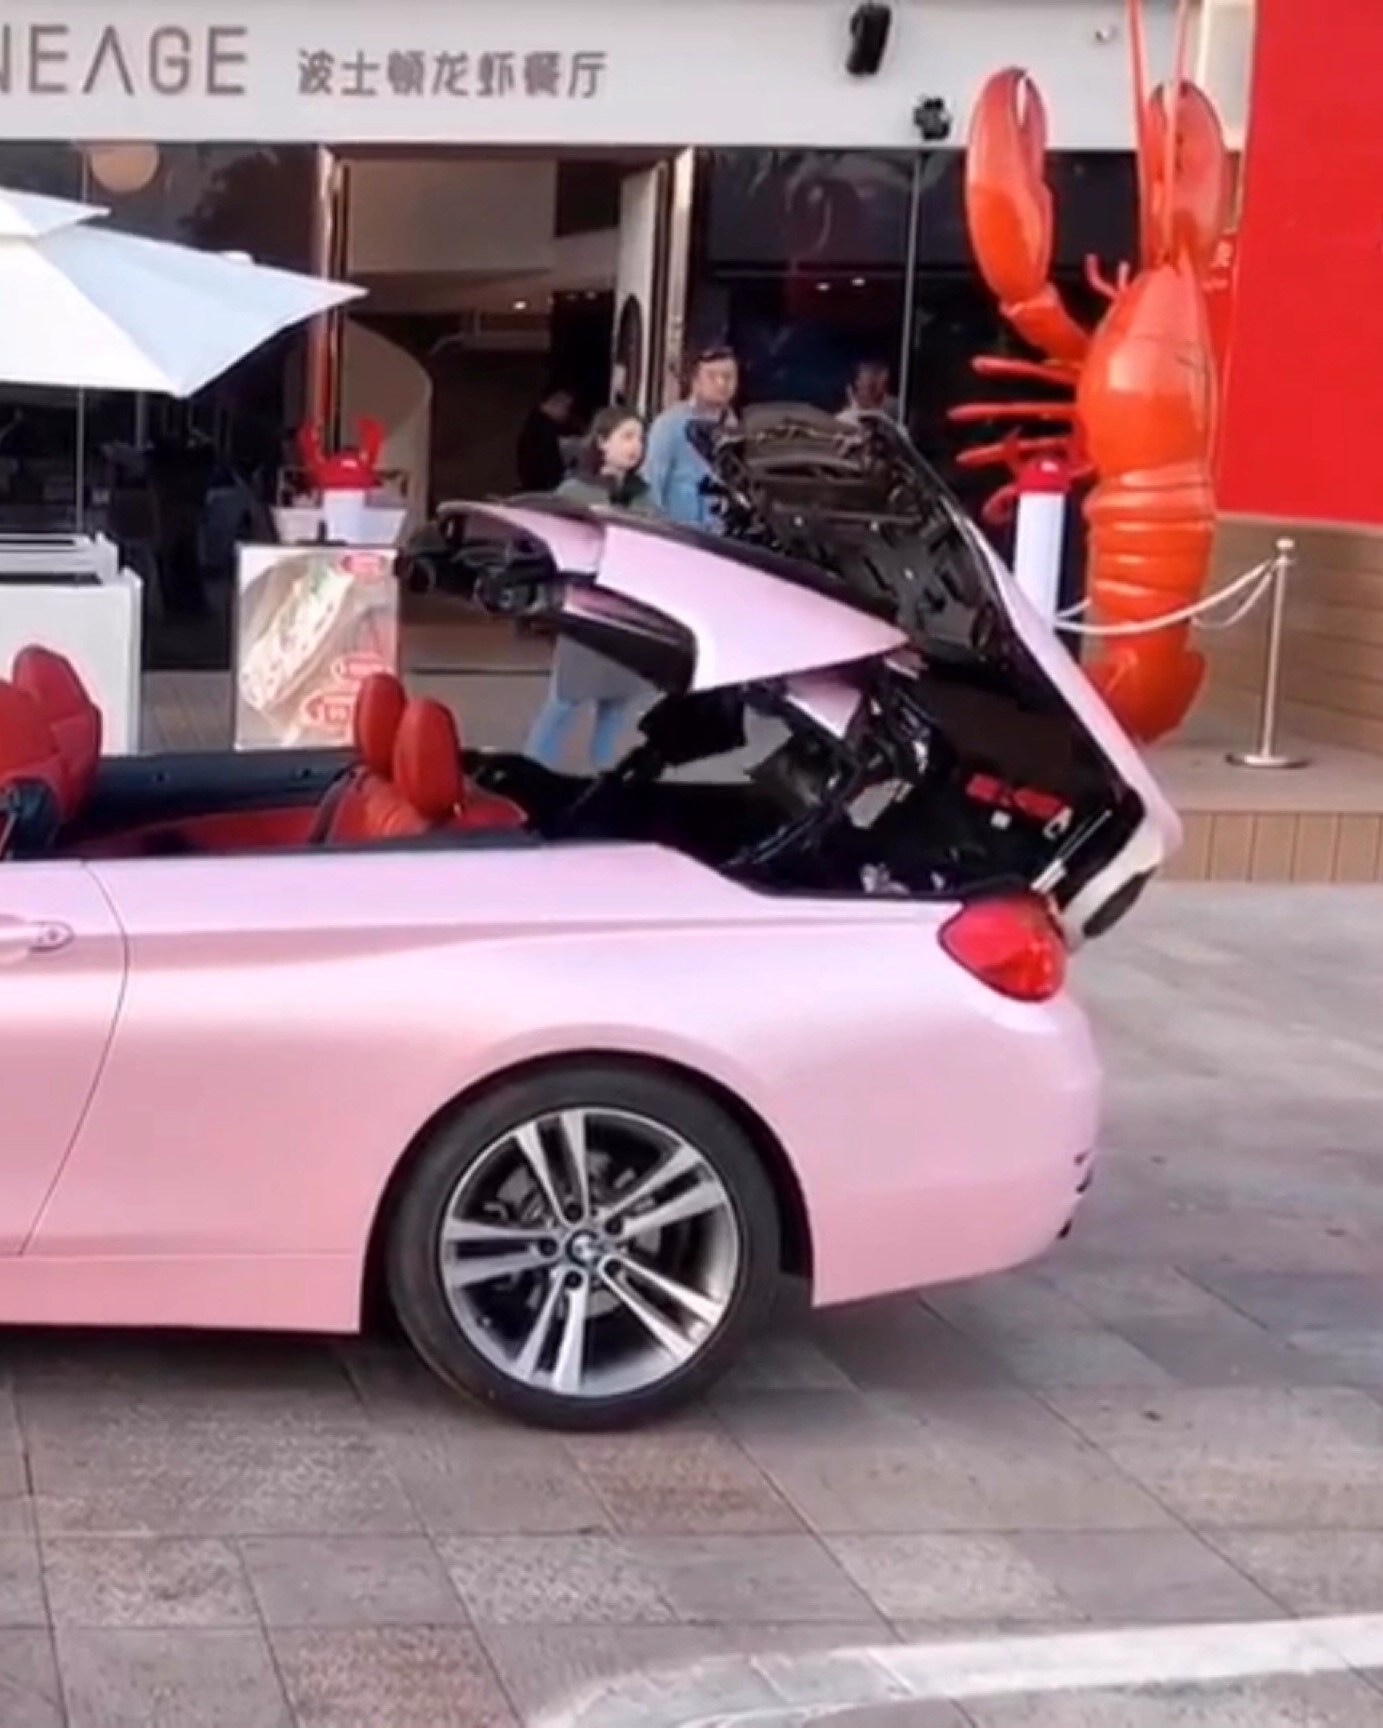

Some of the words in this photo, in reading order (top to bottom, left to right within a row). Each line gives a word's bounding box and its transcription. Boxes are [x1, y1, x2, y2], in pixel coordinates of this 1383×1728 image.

[297, 48, 607, 99] 波士顿龙虾餐厅
